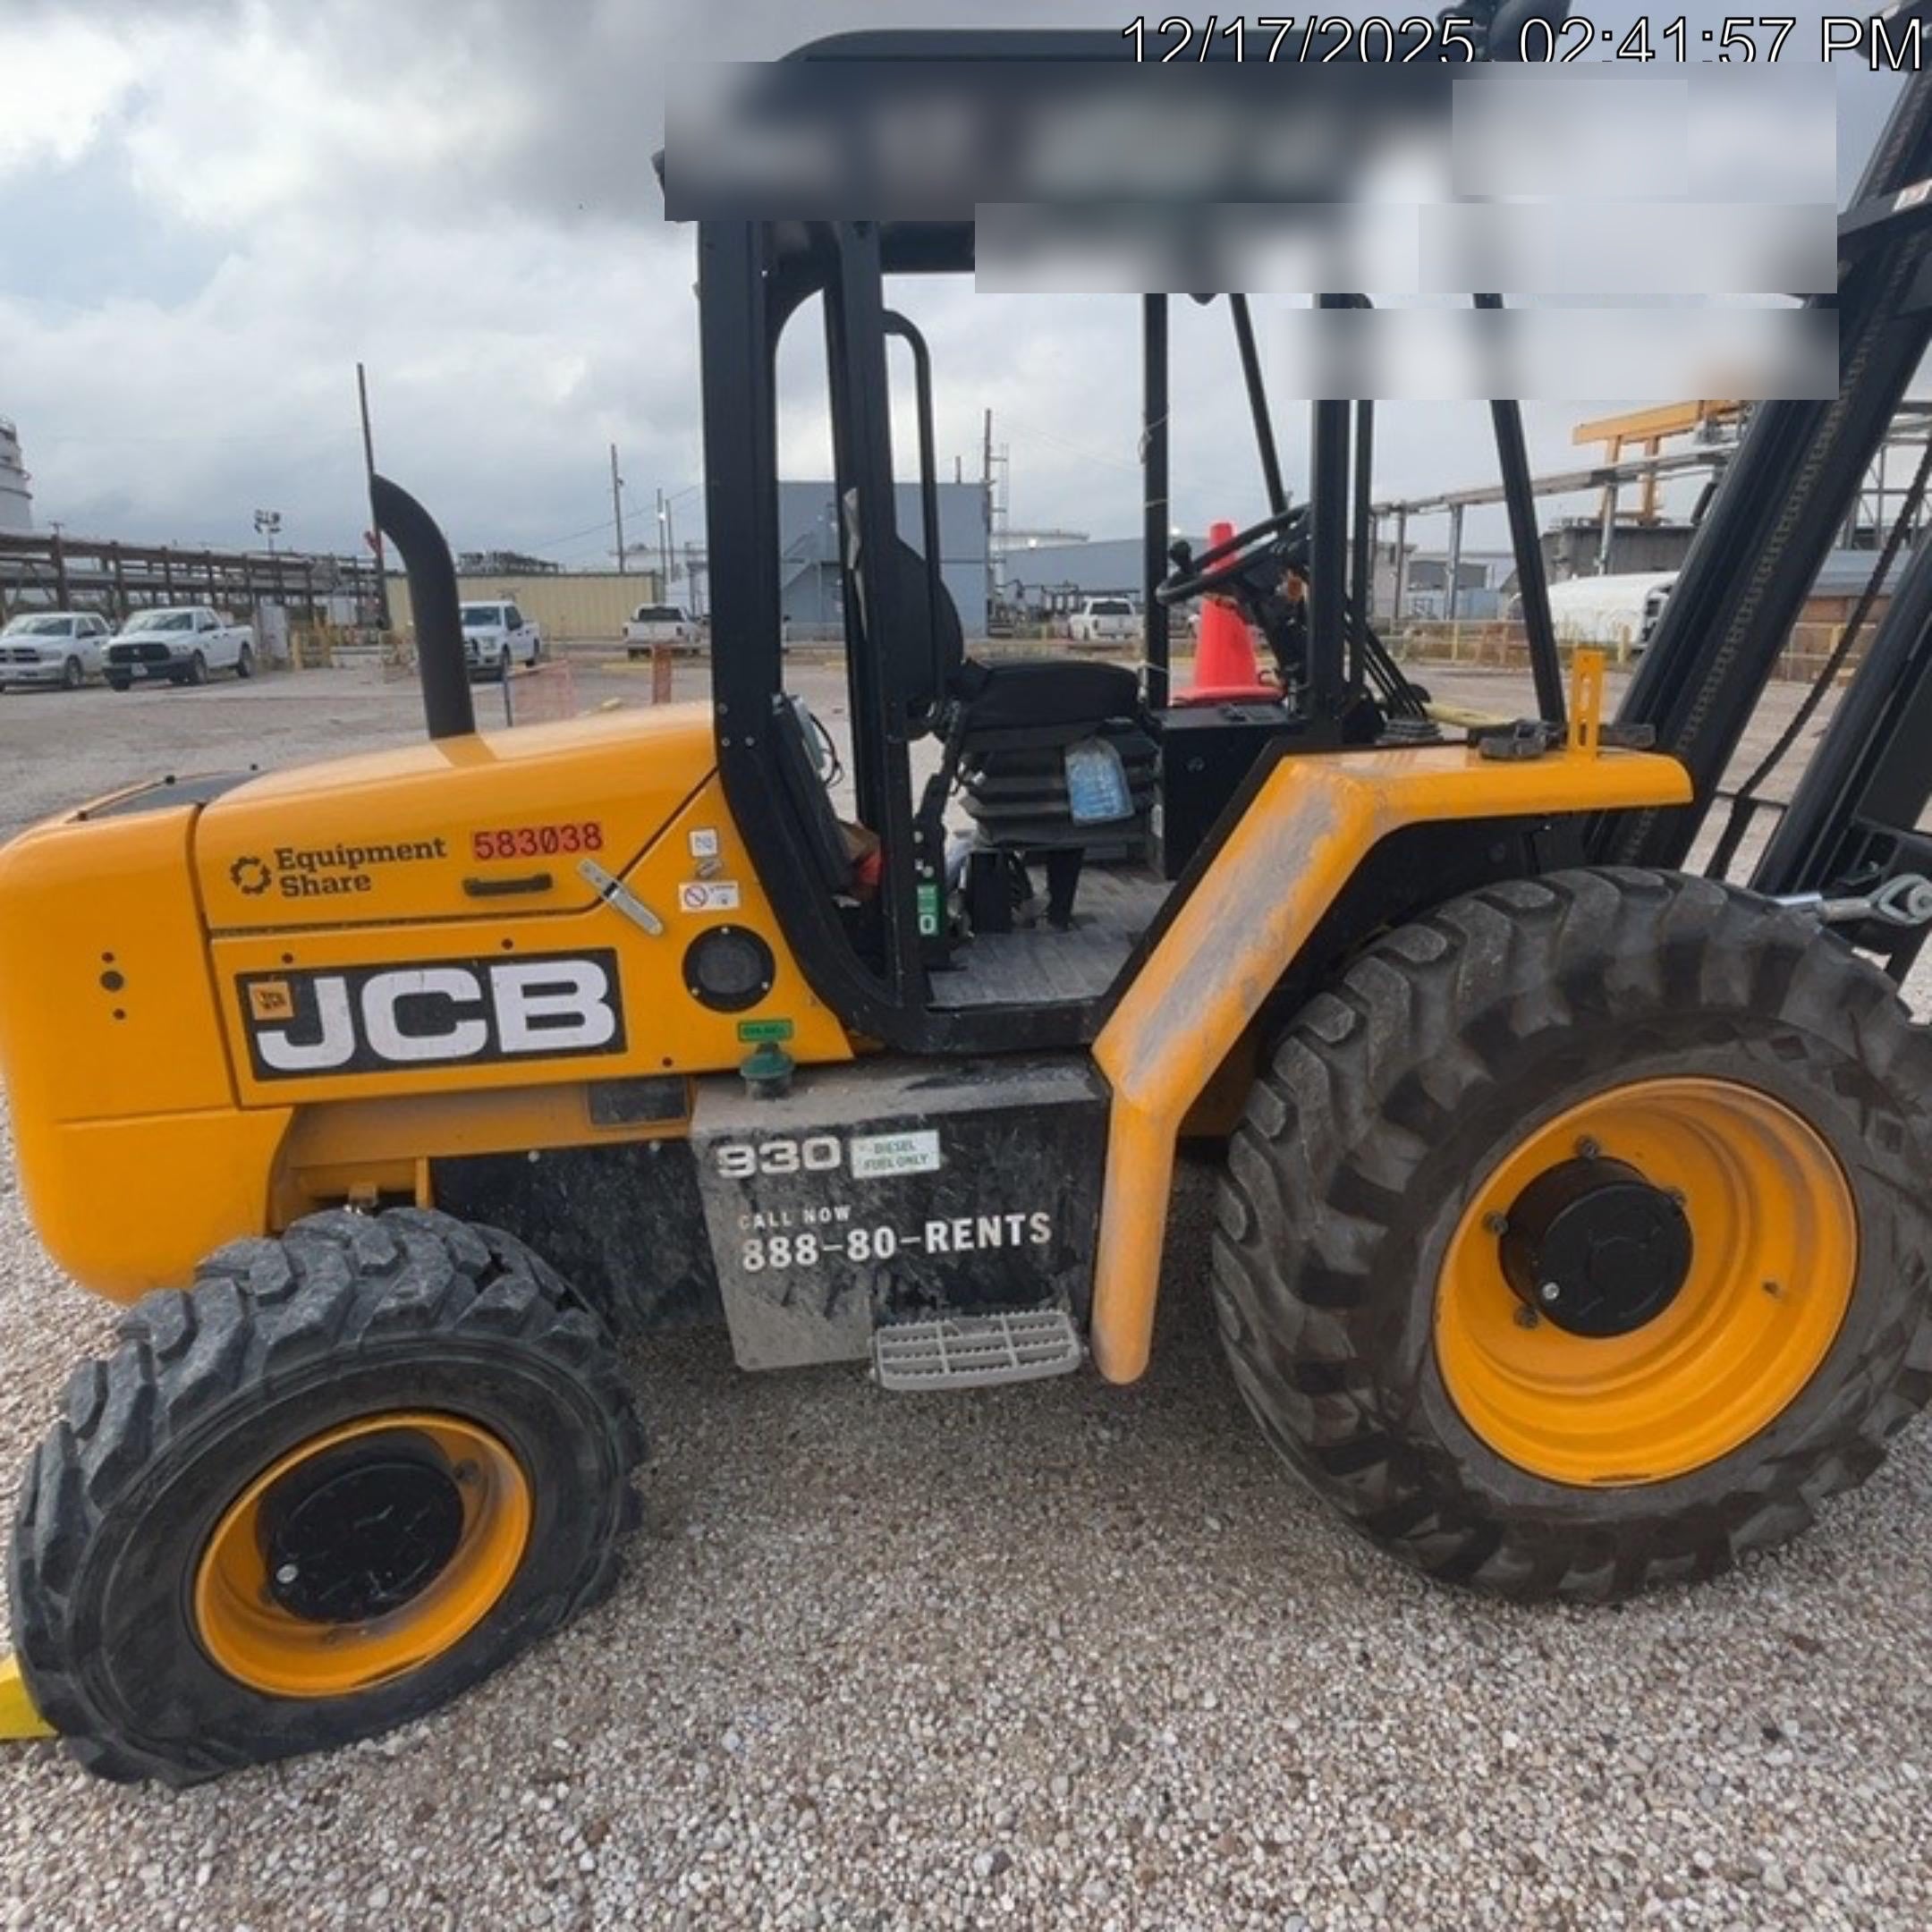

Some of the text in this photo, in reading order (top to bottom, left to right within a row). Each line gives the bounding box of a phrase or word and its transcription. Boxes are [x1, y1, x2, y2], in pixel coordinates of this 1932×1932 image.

[274, 836, 446, 872] Equipment
[473, 822, 604, 860] 583038
[279, 873, 371, 897] Share
[256, 960, 616, 1070] JCB
[716, 1136, 842, 1178] 930
[739, 1205, 852, 1230] CALL NOW
[741, 1212, 1052, 1273] 888-80-RENTS
